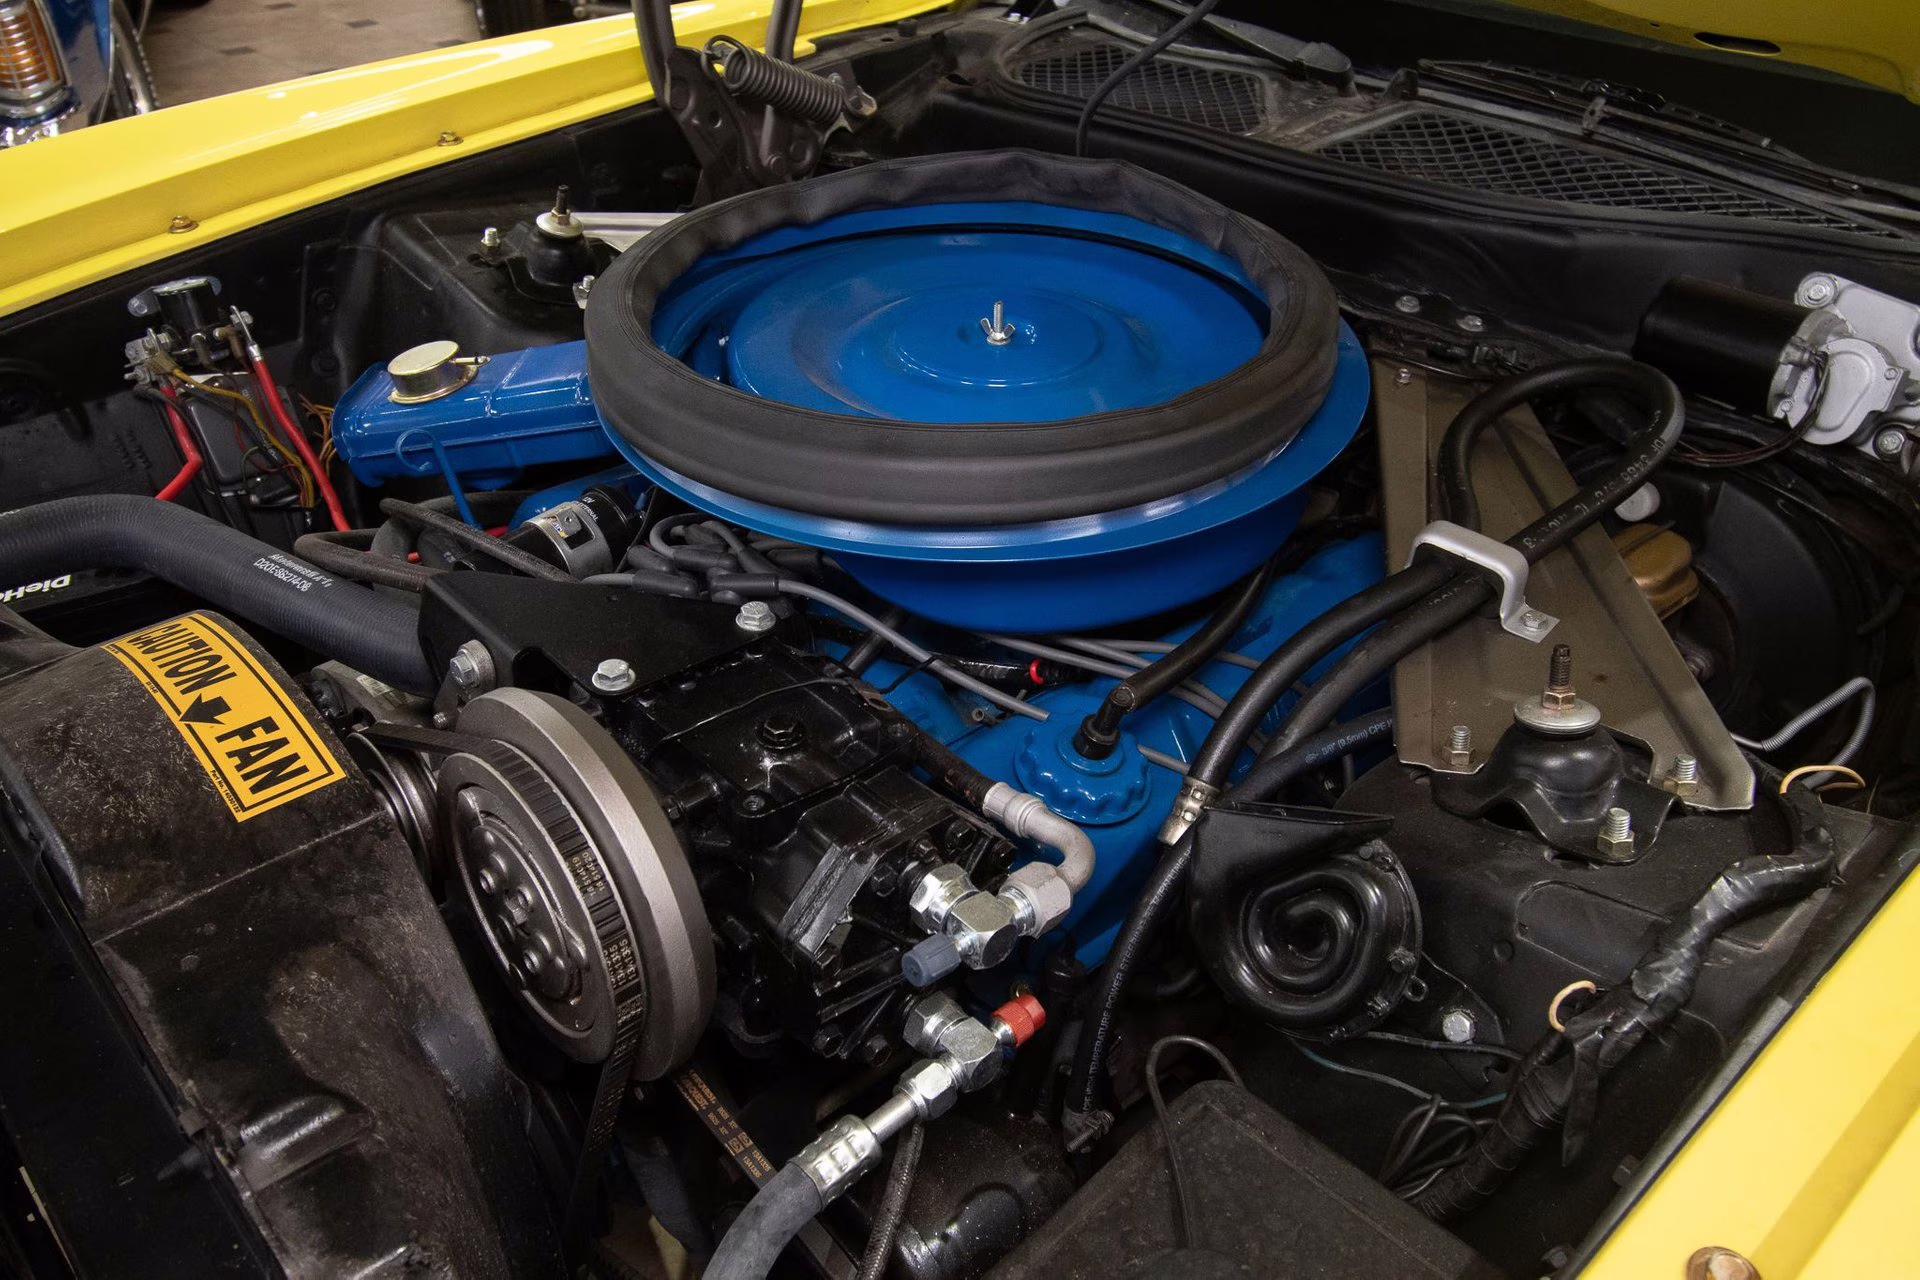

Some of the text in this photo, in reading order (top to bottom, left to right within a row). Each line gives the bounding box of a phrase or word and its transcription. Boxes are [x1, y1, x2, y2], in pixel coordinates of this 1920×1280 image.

[126, 623, 238, 696] CAUTION
[214, 715, 311, 796] FAN
[1368, 721, 1387, 735] CPE
[210, 768, 220, 781] Part
[216, 779, 226, 790] No.
[1088, 1009, 1111, 1075] TEMPERATURE
[1105, 971, 1125, 1010] POWER
[1119, 918, 1148, 971] STEERING
[1144, 876, 1172, 921] RETURN
